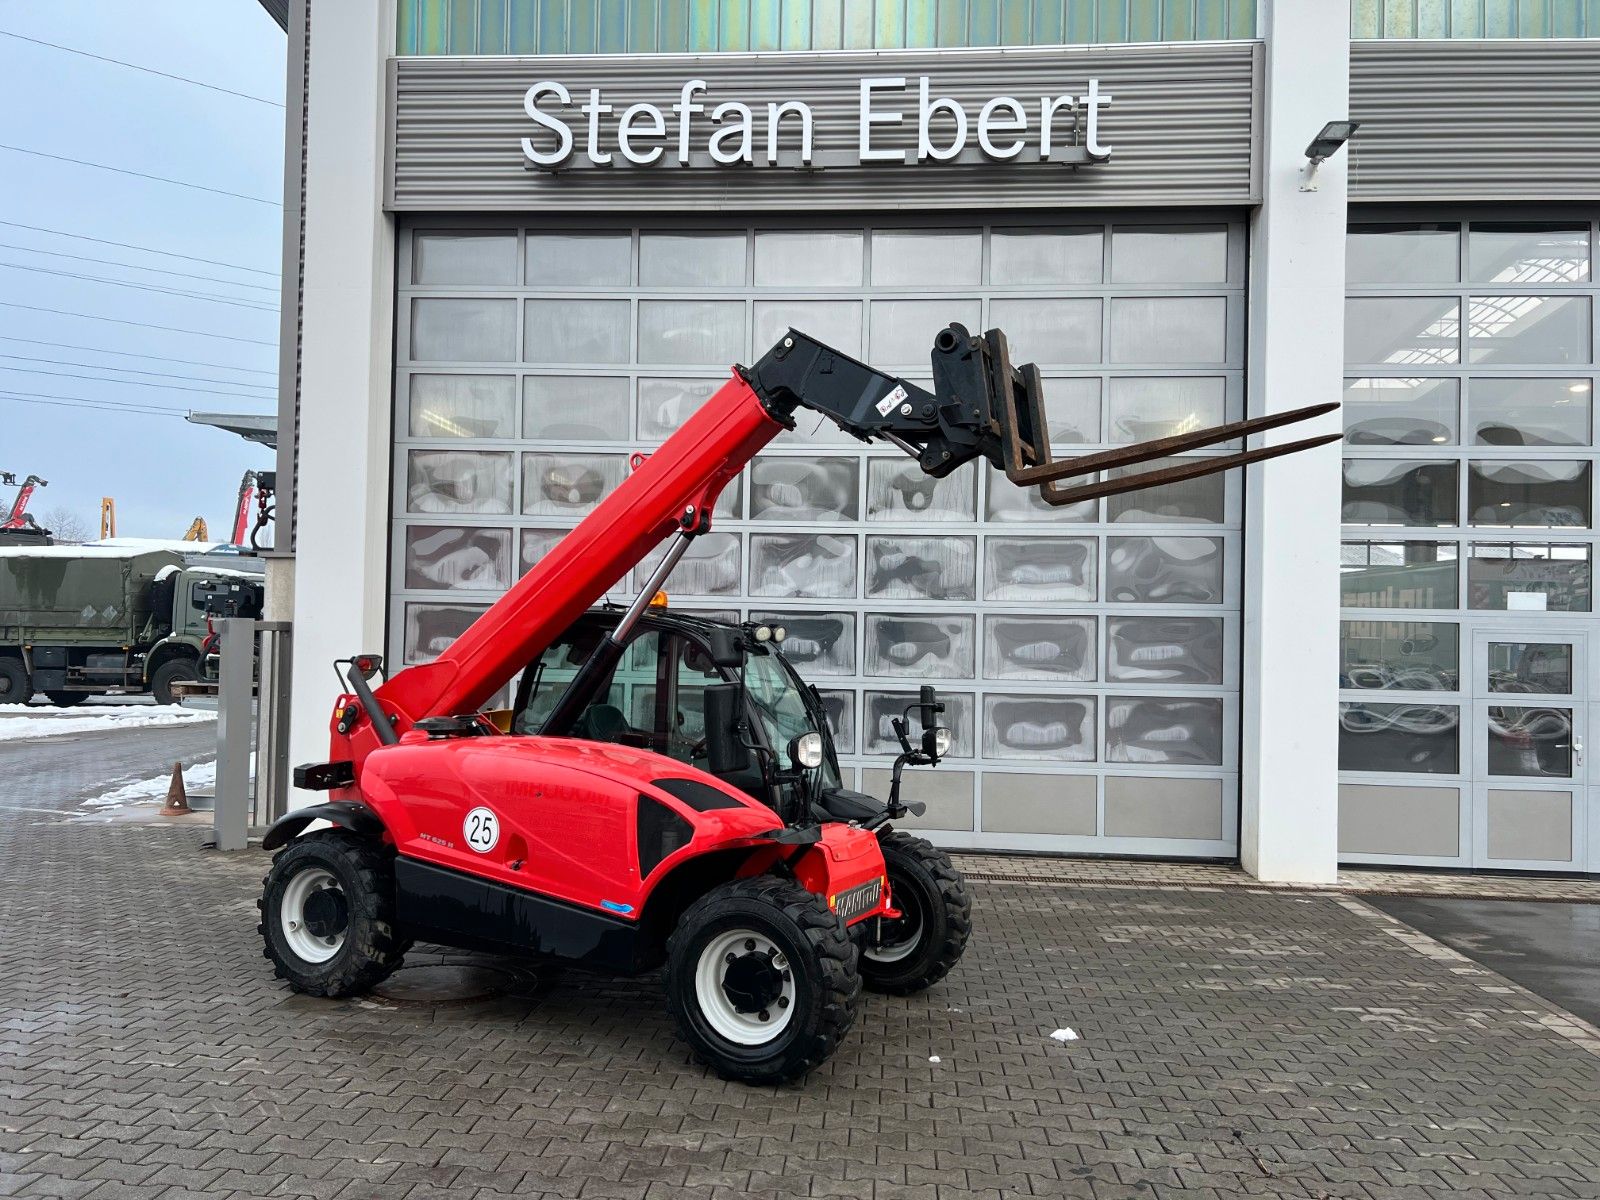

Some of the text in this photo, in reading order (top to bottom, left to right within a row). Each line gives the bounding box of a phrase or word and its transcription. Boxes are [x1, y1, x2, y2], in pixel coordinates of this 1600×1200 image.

[521, 75, 1113, 167] Stefan Ebert
[419, 832, 431, 840] MT
[431, 836, 447, 846] 625
[469, 815, 493, 845] 25
